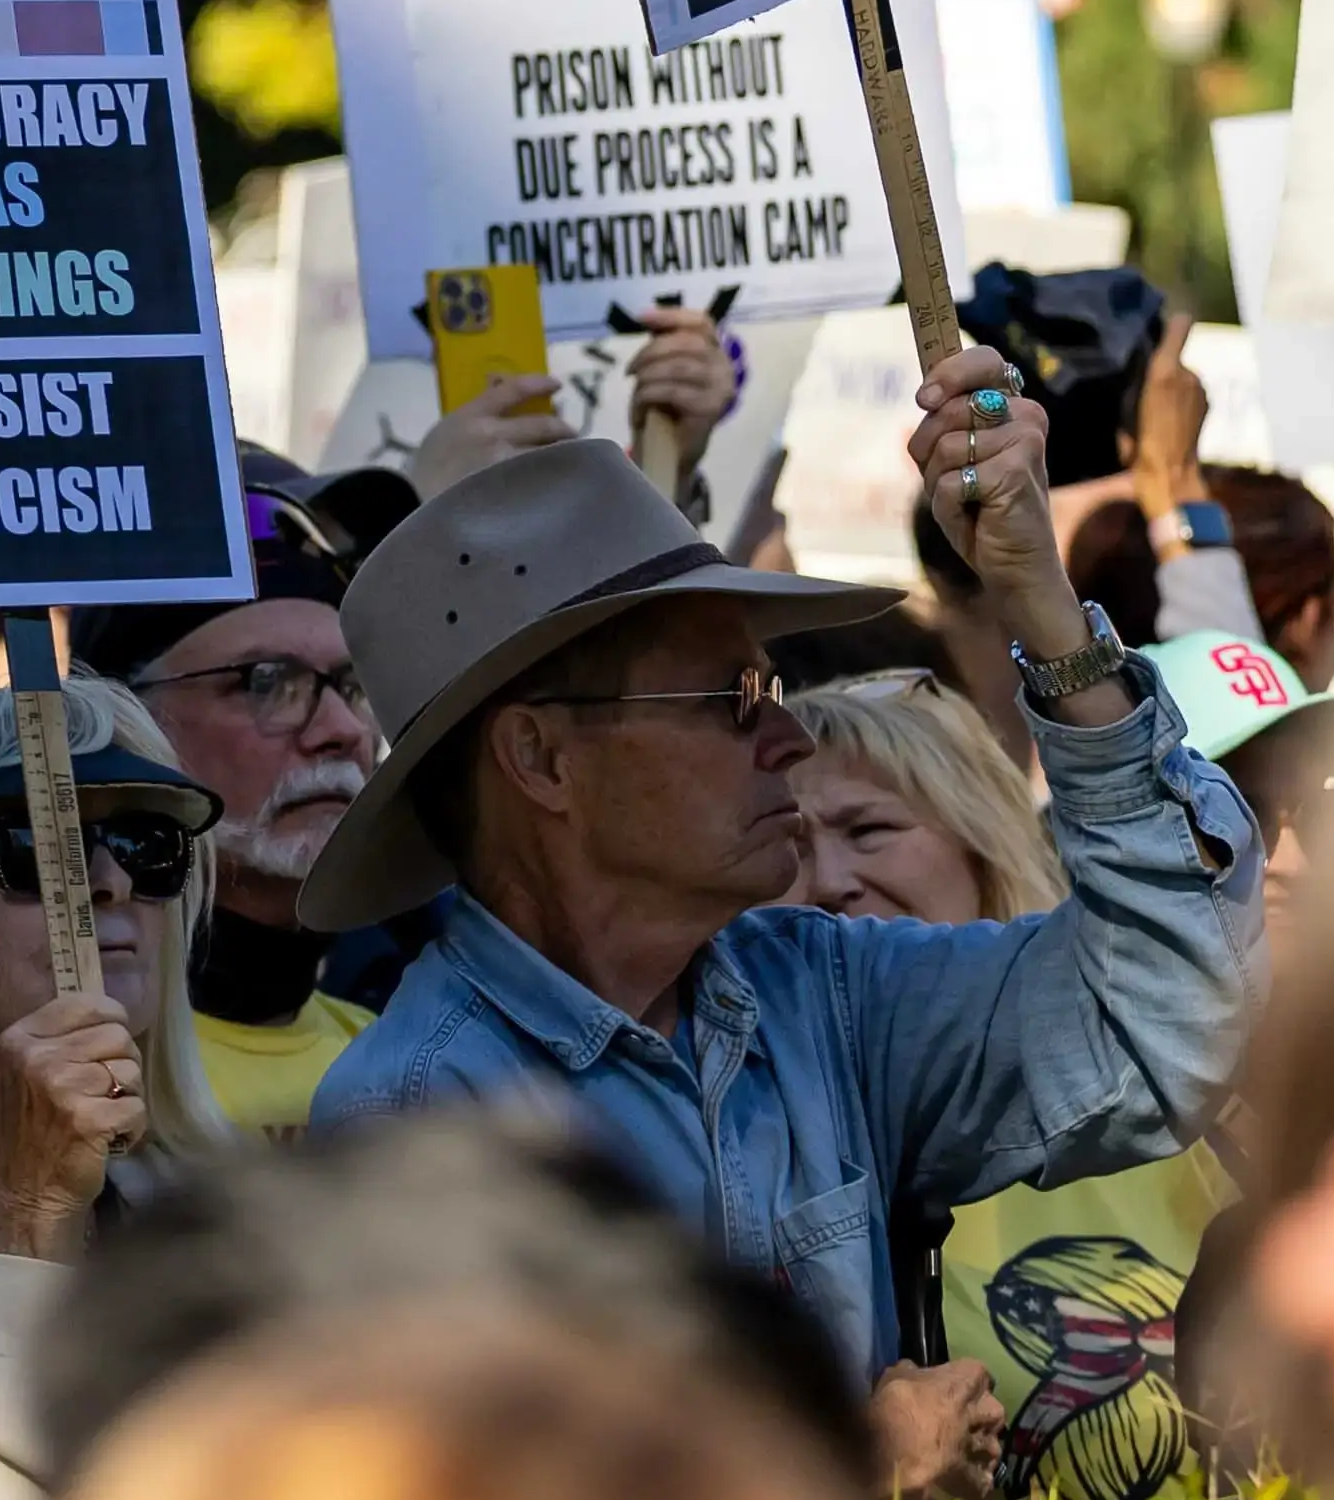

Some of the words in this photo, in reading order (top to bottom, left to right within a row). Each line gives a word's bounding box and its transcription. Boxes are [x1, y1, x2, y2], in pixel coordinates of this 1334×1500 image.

[512, 46, 634, 119] PRISON
[646, 33, 785, 106] WITHOUT
[853, 8, 894, 136] HARDWARE
[514, 133, 583, 202] DUE
[594, 122, 736, 196] PROCESS
[748, 117, 779, 183] IS
[792, 113, 813, 179] A
[485, 203, 751, 285] CONCENTRATION
[763, 195, 850, 263] CAMP
[65, 826, 86, 886] California
